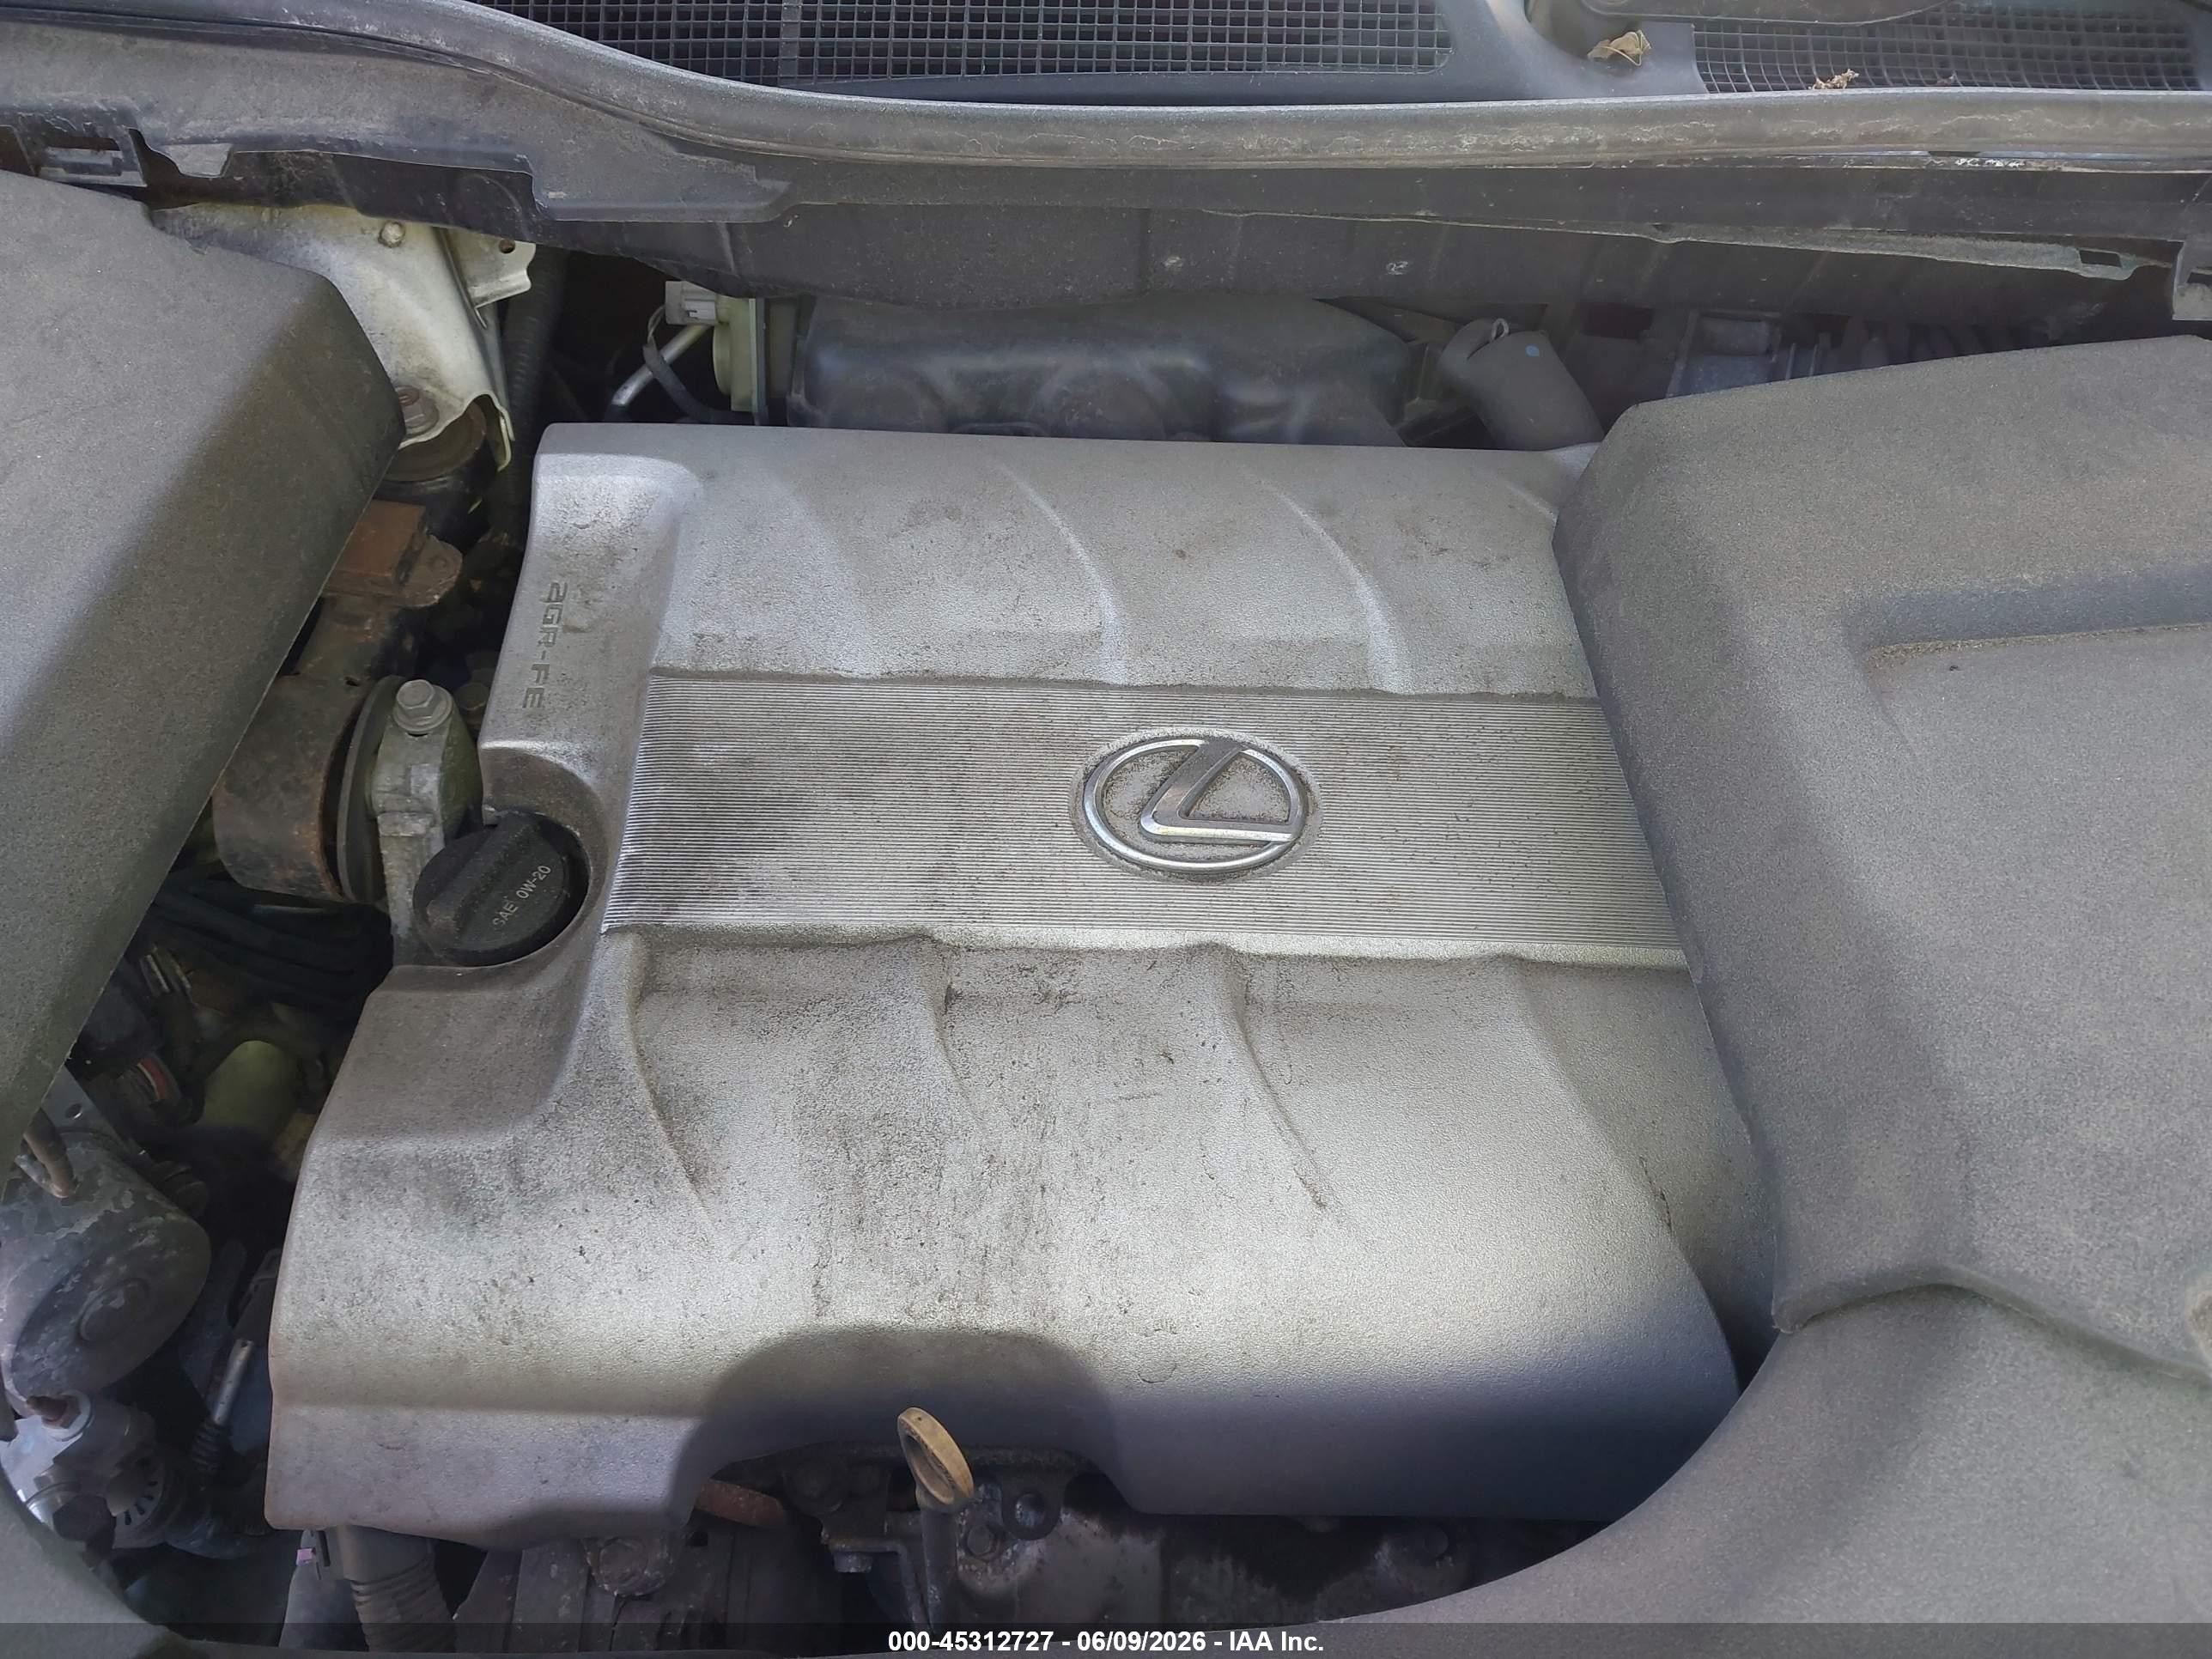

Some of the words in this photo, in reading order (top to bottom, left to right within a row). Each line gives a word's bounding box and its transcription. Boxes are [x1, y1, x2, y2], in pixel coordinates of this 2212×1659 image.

[524, 582, 568, 708] 2GR-FE
[493, 901, 519, 926] SAE
[516, 865, 551, 899] 0W-20
